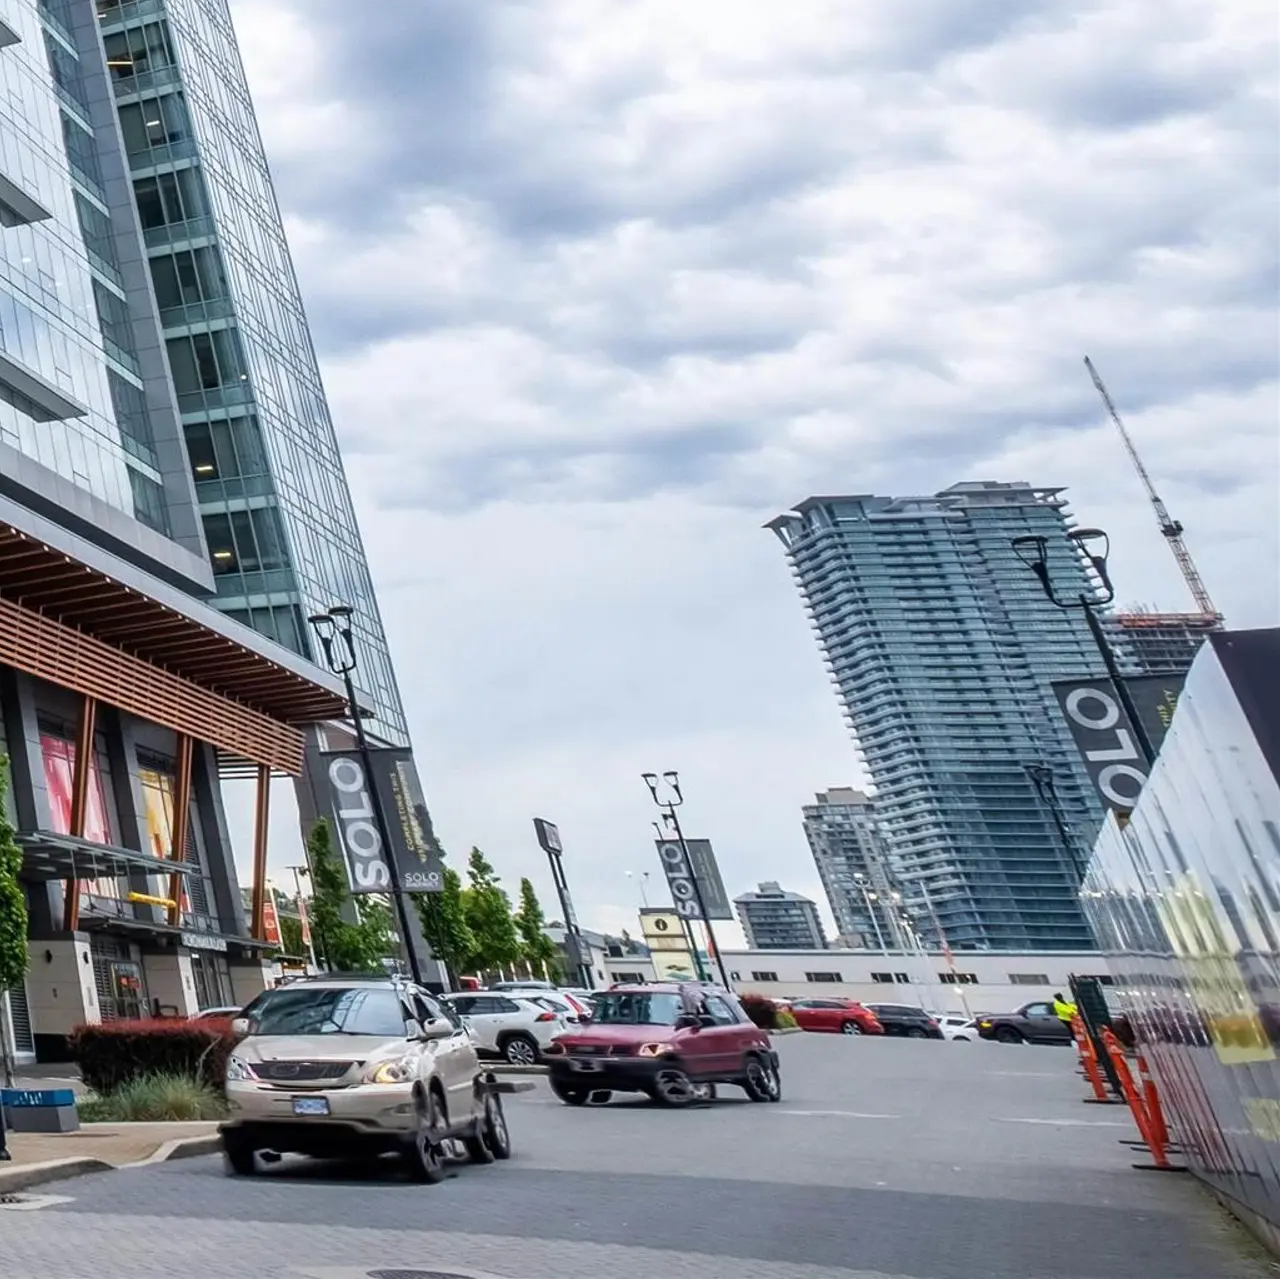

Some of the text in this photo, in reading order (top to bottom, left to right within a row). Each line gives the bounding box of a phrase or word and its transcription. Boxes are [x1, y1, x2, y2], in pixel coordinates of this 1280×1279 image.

[1065, 687, 1149, 808] OLO
[328, 757, 390, 887] SOLO
[405, 871, 439, 883] SOLO
[660, 843, 700, 916] SOLO
